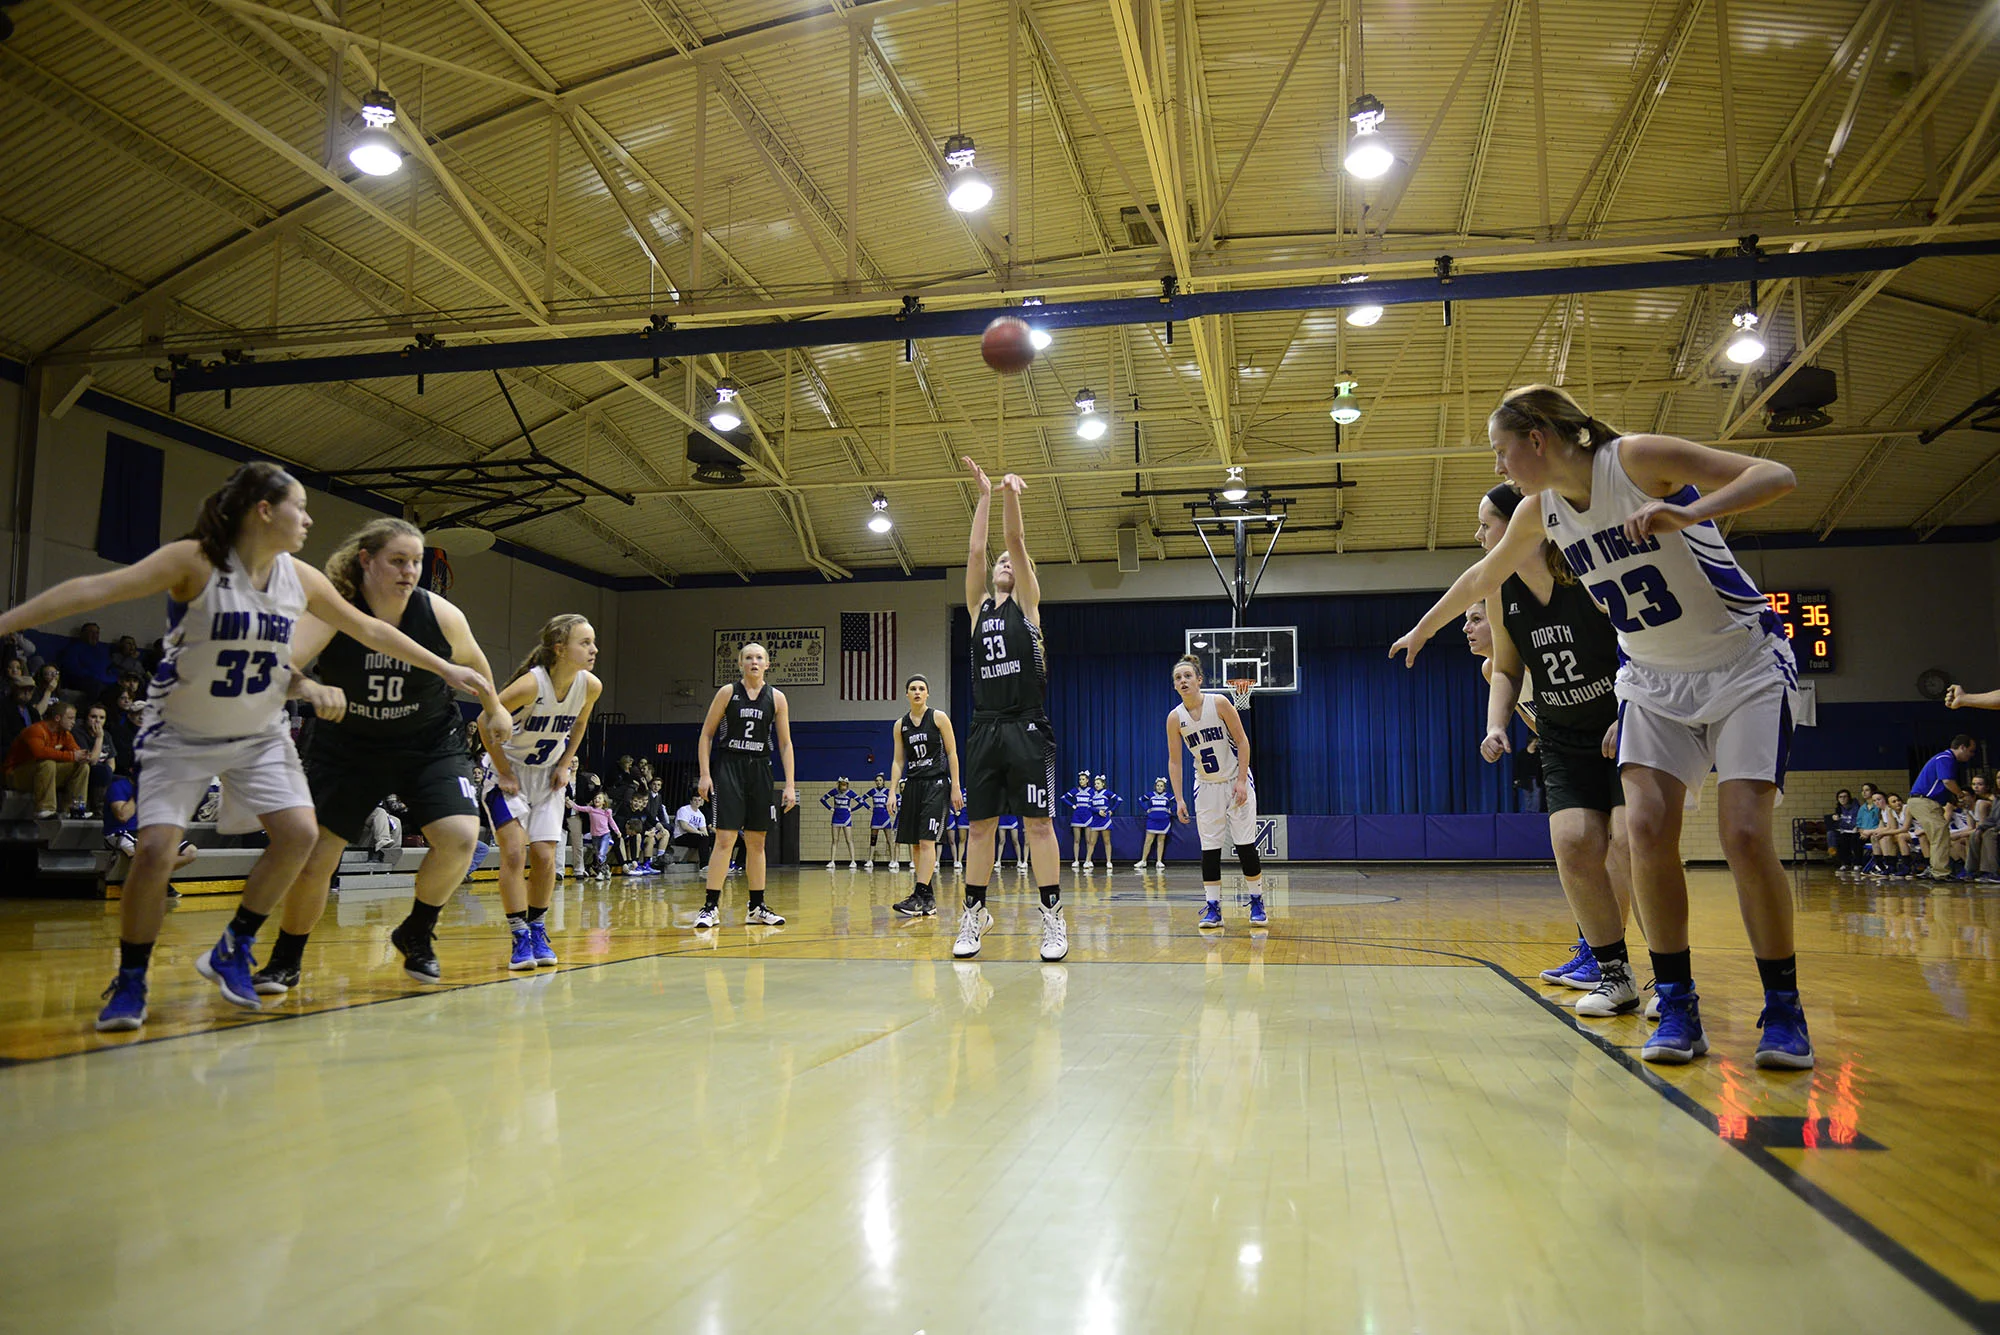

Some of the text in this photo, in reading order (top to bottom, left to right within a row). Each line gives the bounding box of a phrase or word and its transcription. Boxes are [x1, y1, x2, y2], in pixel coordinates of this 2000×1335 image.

[1563, 538, 1596, 577] ADY
[1588, 564, 1683, 633] 23
[1802, 605, 1829, 626] 36
[210, 611, 295, 645] LADY TIGE
[720, 630, 820, 642] STATE 2A VOLLEYBALL
[1530, 625, 1574, 649] NORTH
[767, 640, 803, 650] PLACE
[982, 634, 1007, 662] 33
[1815, 640, 1827, 656] 0
[210, 649, 278, 697] 33
[1541, 650, 1585, 685] 22
[367, 675, 404, 702] 50
[1540, 676, 1614, 707] CALLAWAY
[551, 715, 577, 733] TIGE
[740, 708, 763, 720] NORTH
[744, 721, 755, 738] 2
[909, 733, 928, 744] NORTH
[1200, 726, 1224, 743] TIGERS
[524, 739, 558, 765] 3
[729, 739, 764, 752] CALLAWAY
[913, 744, 927, 759] 10
[1200, 747, 1220, 774] 5
